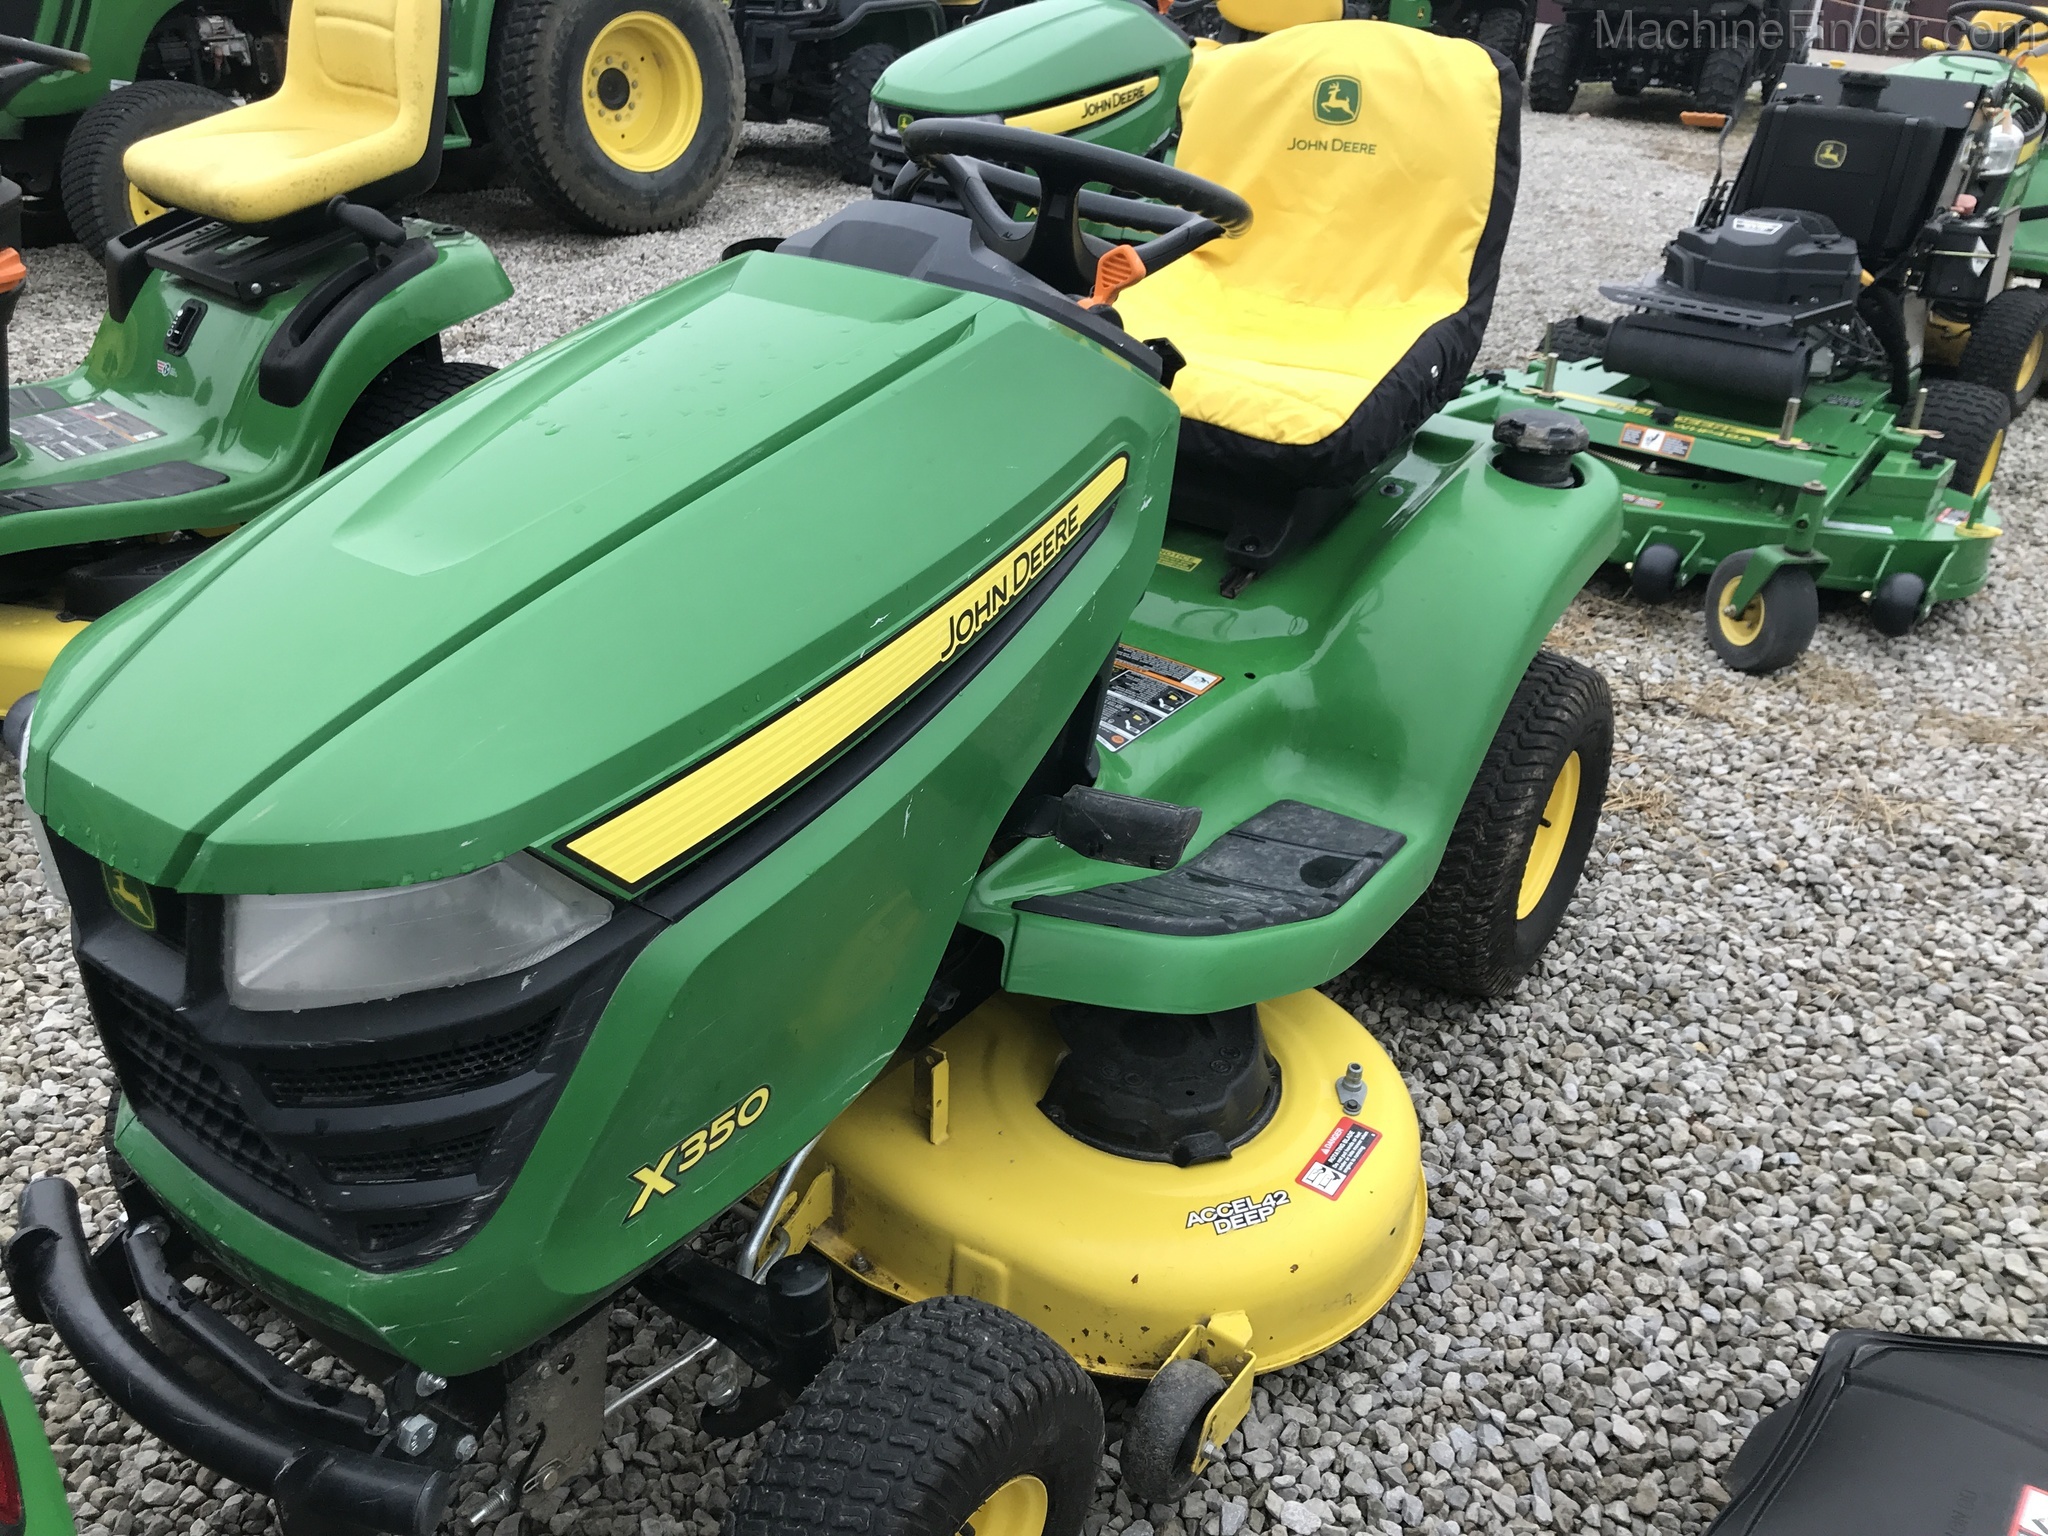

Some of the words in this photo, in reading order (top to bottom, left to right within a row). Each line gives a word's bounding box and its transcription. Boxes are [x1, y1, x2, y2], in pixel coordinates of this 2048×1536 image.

[1081, 98, 1112, 120] JOHN
[1112, 85, 1145, 109] DEERE
[1287, 138, 1328, 151] JOHN
[1331, 138, 1377, 155] DEERE
[940, 574, 1009, 662] JOHN
[1013, 504, 1080, 595] DEERE
[621, 1085, 771, 1224] X350
[1323, 1127, 1344, 1149] DANGER
[1327, 1142, 1345, 1163] ROTATING
[1341, 1129, 1355, 1144] BLADE
[1213, 1206, 1276, 1235] DEEP
